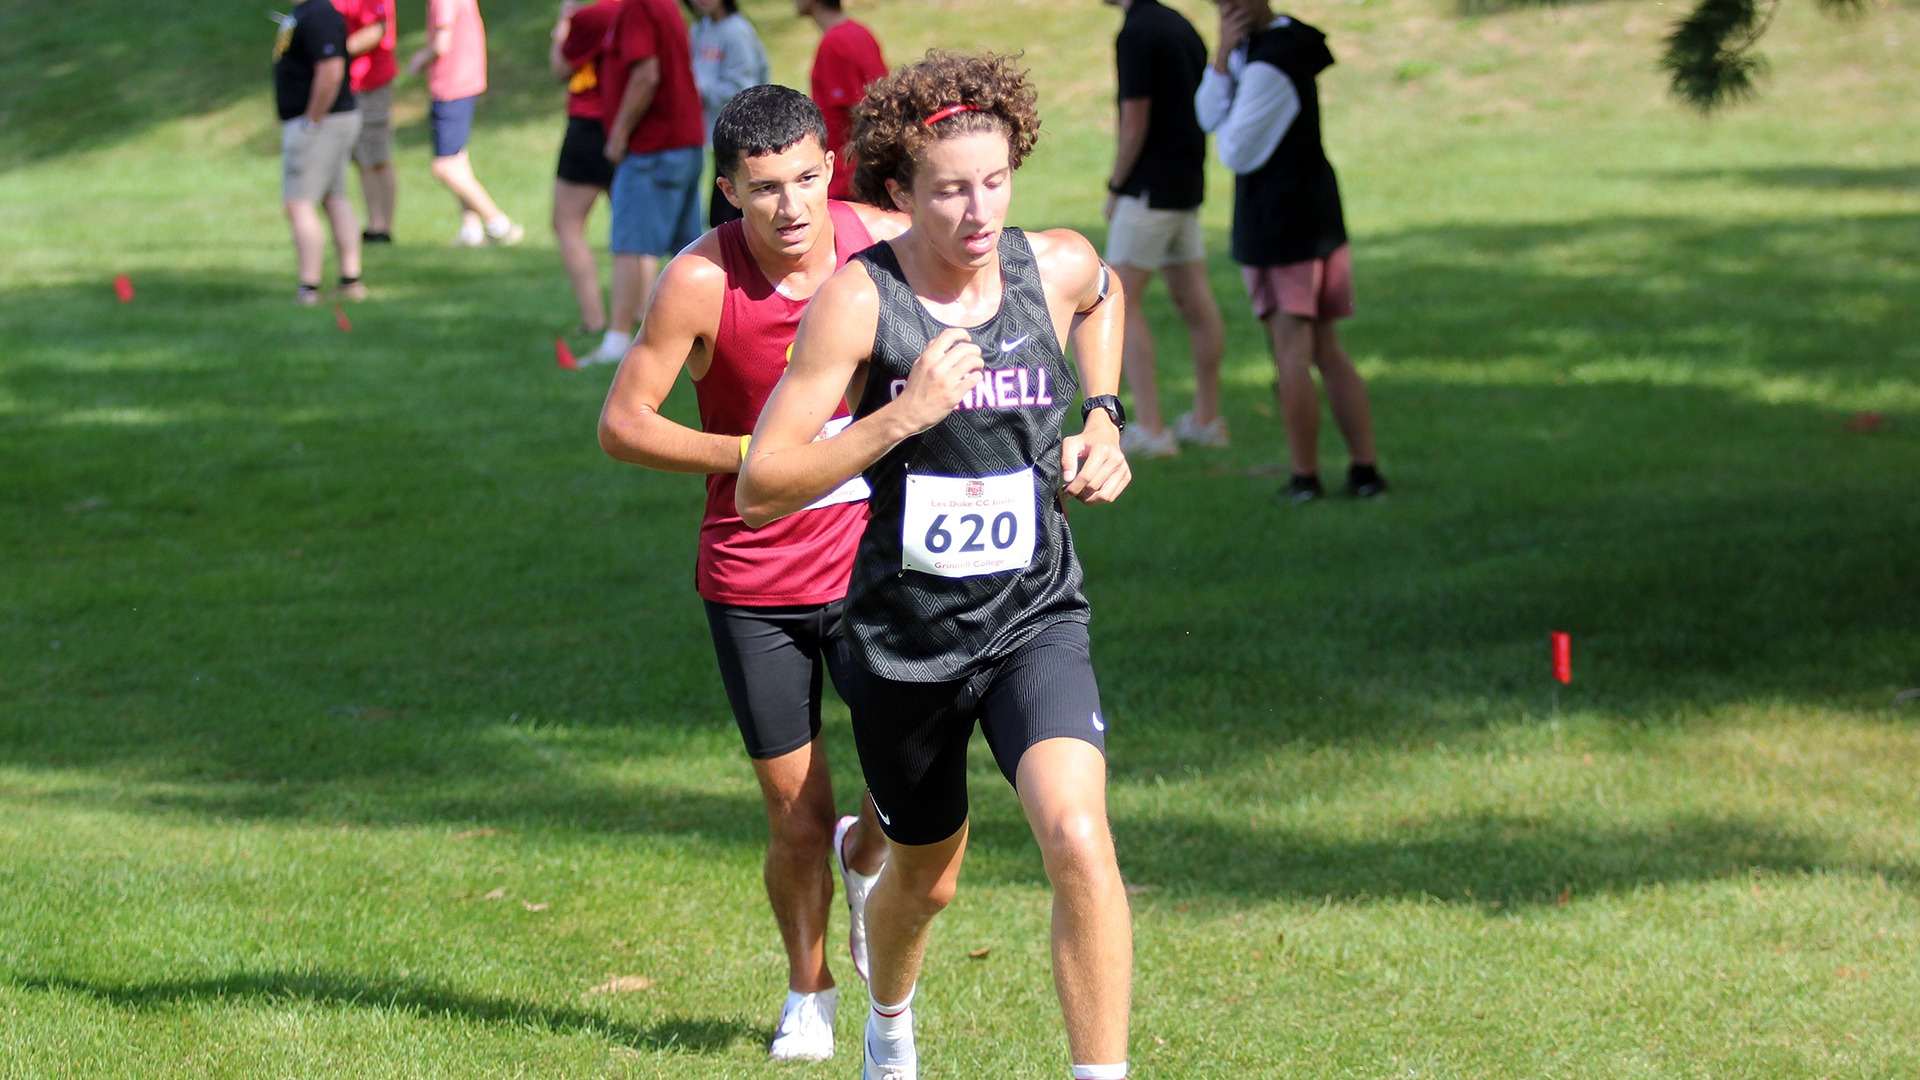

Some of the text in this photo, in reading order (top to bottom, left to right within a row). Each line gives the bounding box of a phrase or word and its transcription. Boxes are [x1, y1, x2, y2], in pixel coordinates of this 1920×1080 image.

[890, 367, 1053, 411] NNELL
[931, 500, 946, 508] Les
[949, 500, 973, 508] Duke
[975, 499, 990, 507] CC
[924, 511, 1018, 554] 620
[934, 559, 1005, 570] Grinnell College
